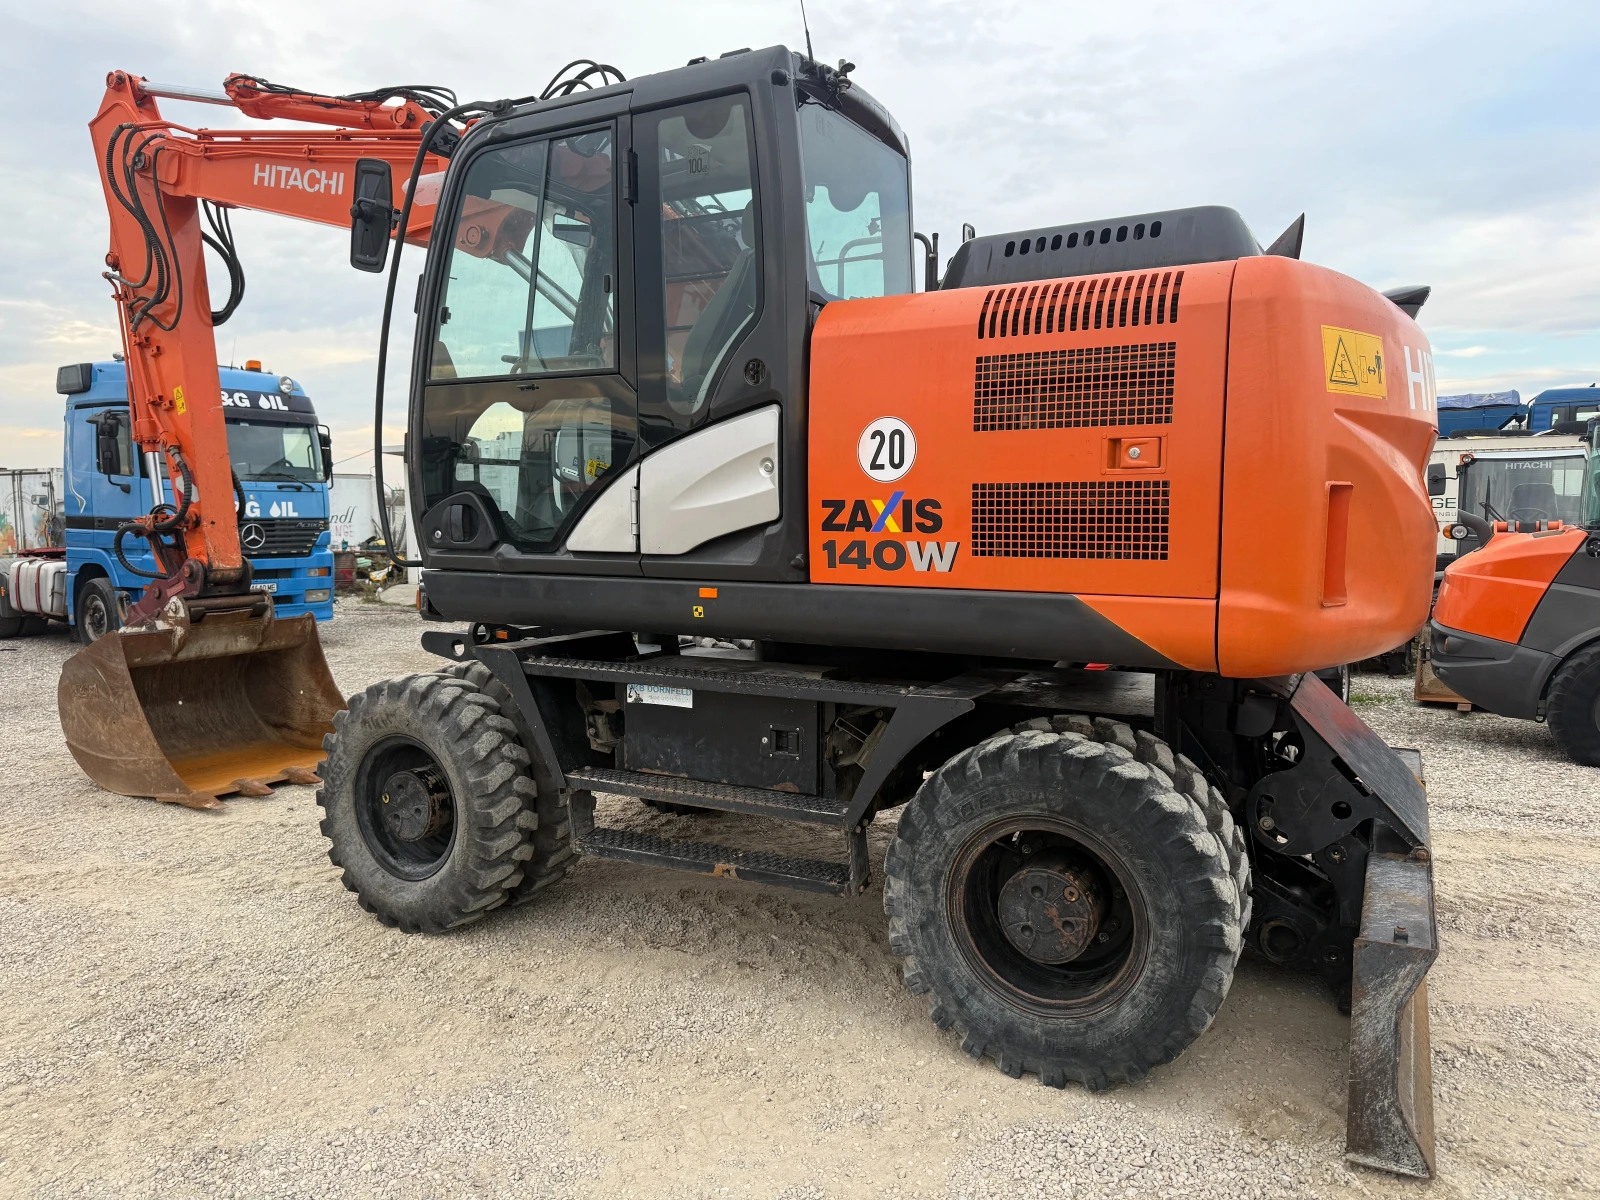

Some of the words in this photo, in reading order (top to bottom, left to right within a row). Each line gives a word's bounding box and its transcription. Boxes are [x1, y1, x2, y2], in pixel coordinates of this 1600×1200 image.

[253, 163, 345, 195] HITACHI
[869, 428, 905, 470] 20
[1505, 461, 1552, 470] HITACHI
[234, 501, 260, 517] G
[821, 491, 943, 534] ZAXIS
[822, 540, 961, 573] 140W
